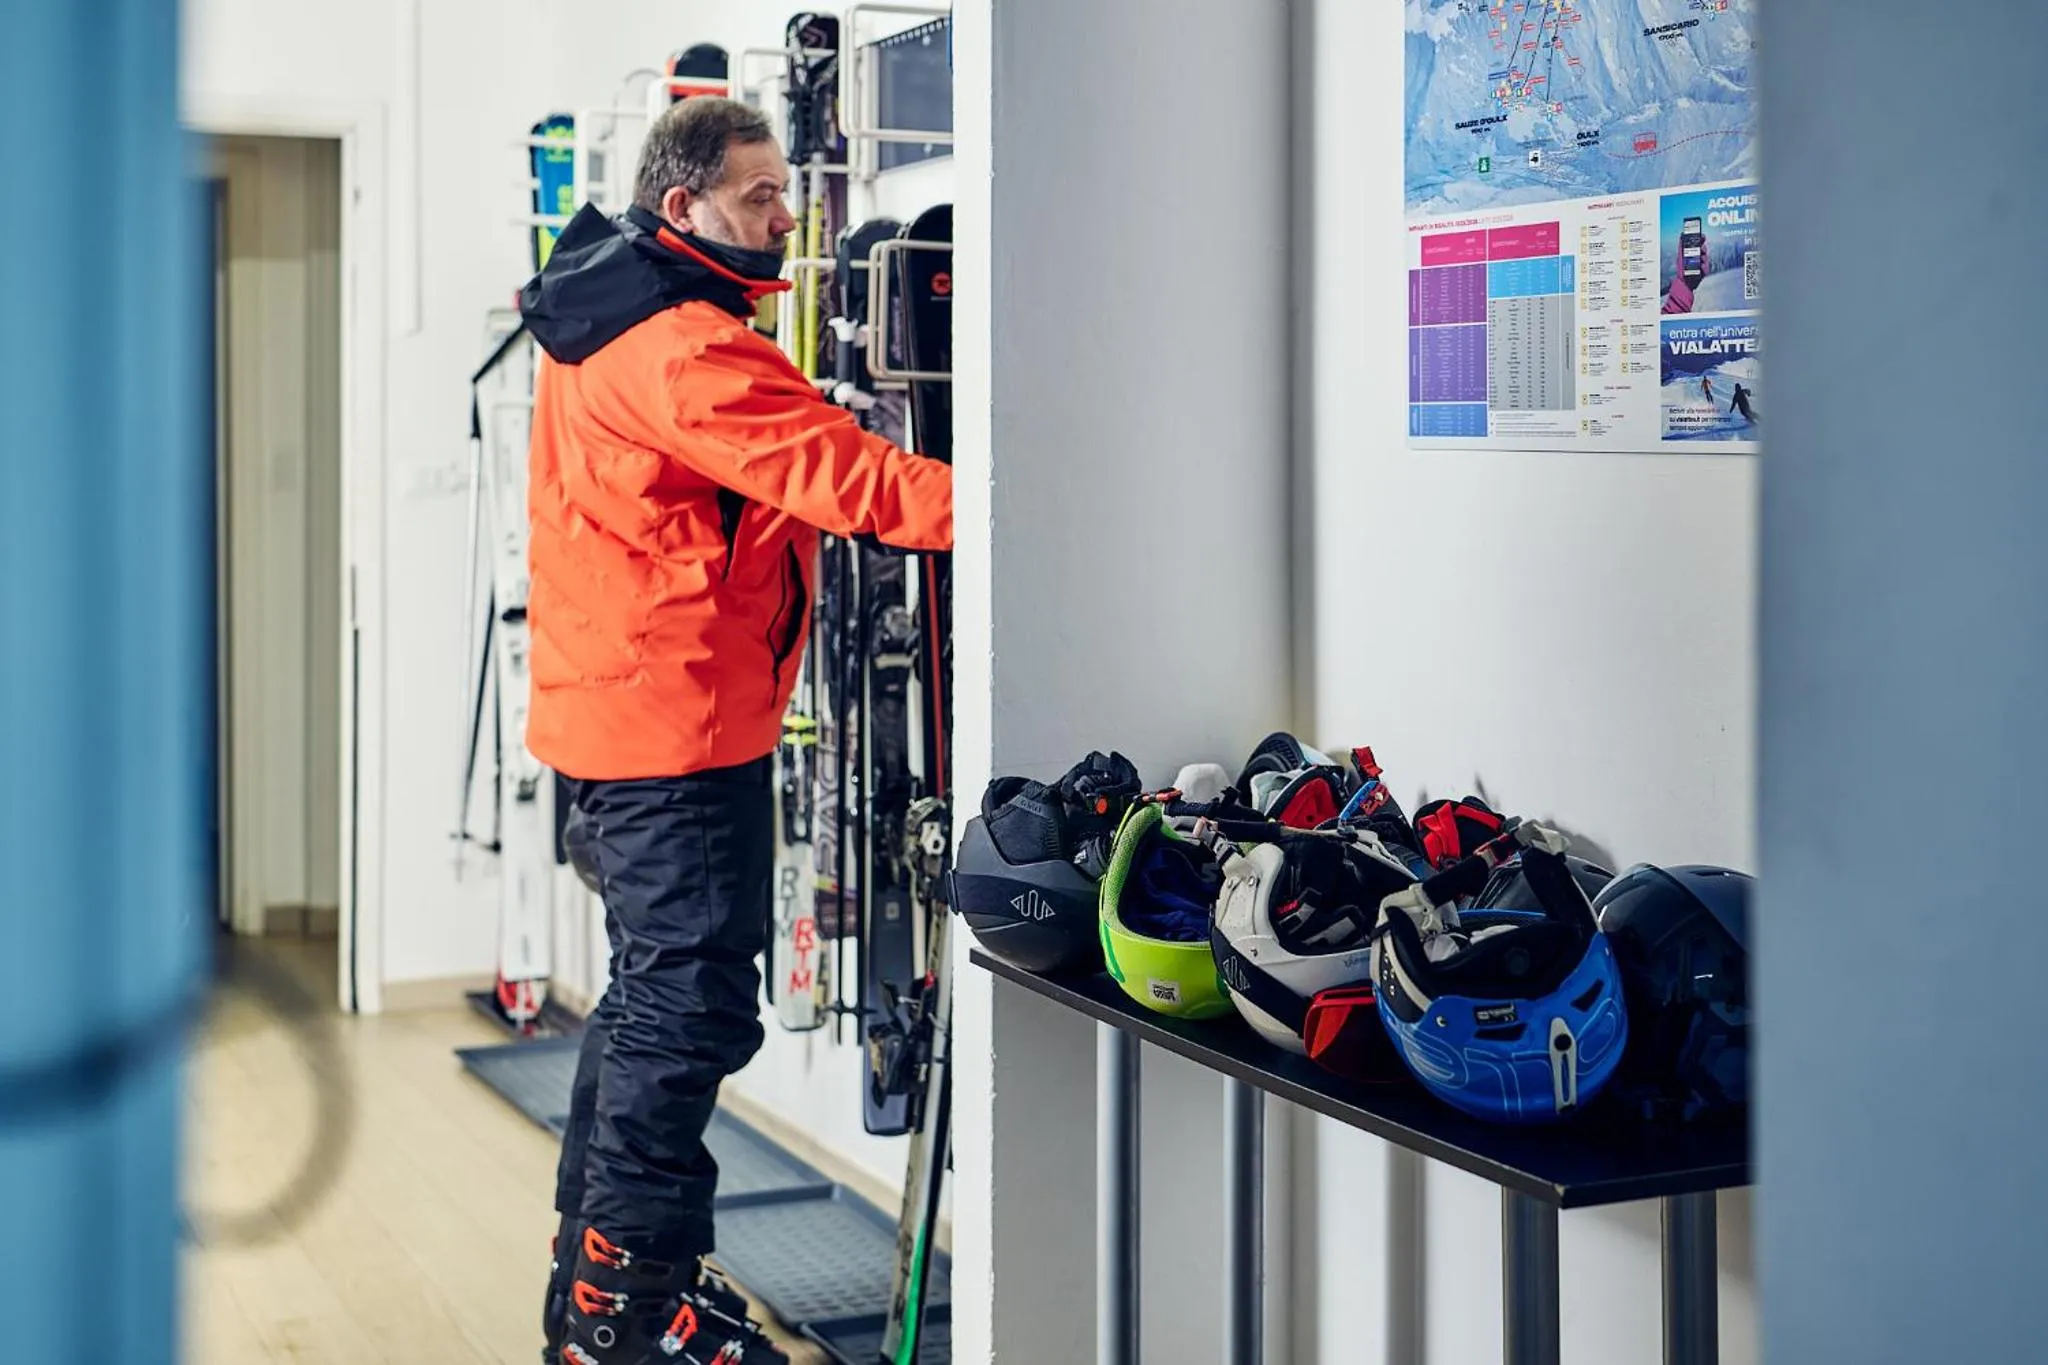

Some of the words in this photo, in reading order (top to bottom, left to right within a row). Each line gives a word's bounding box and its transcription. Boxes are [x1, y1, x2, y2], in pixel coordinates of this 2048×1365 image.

[1643, 18, 1700, 37] SANSICARIO
[1576, 129, 1600, 140] OULX
[1669, 327, 1698, 339] entra
[1669, 338, 1759, 355] VIALATTE
[789, 916, 815, 996] RTM
